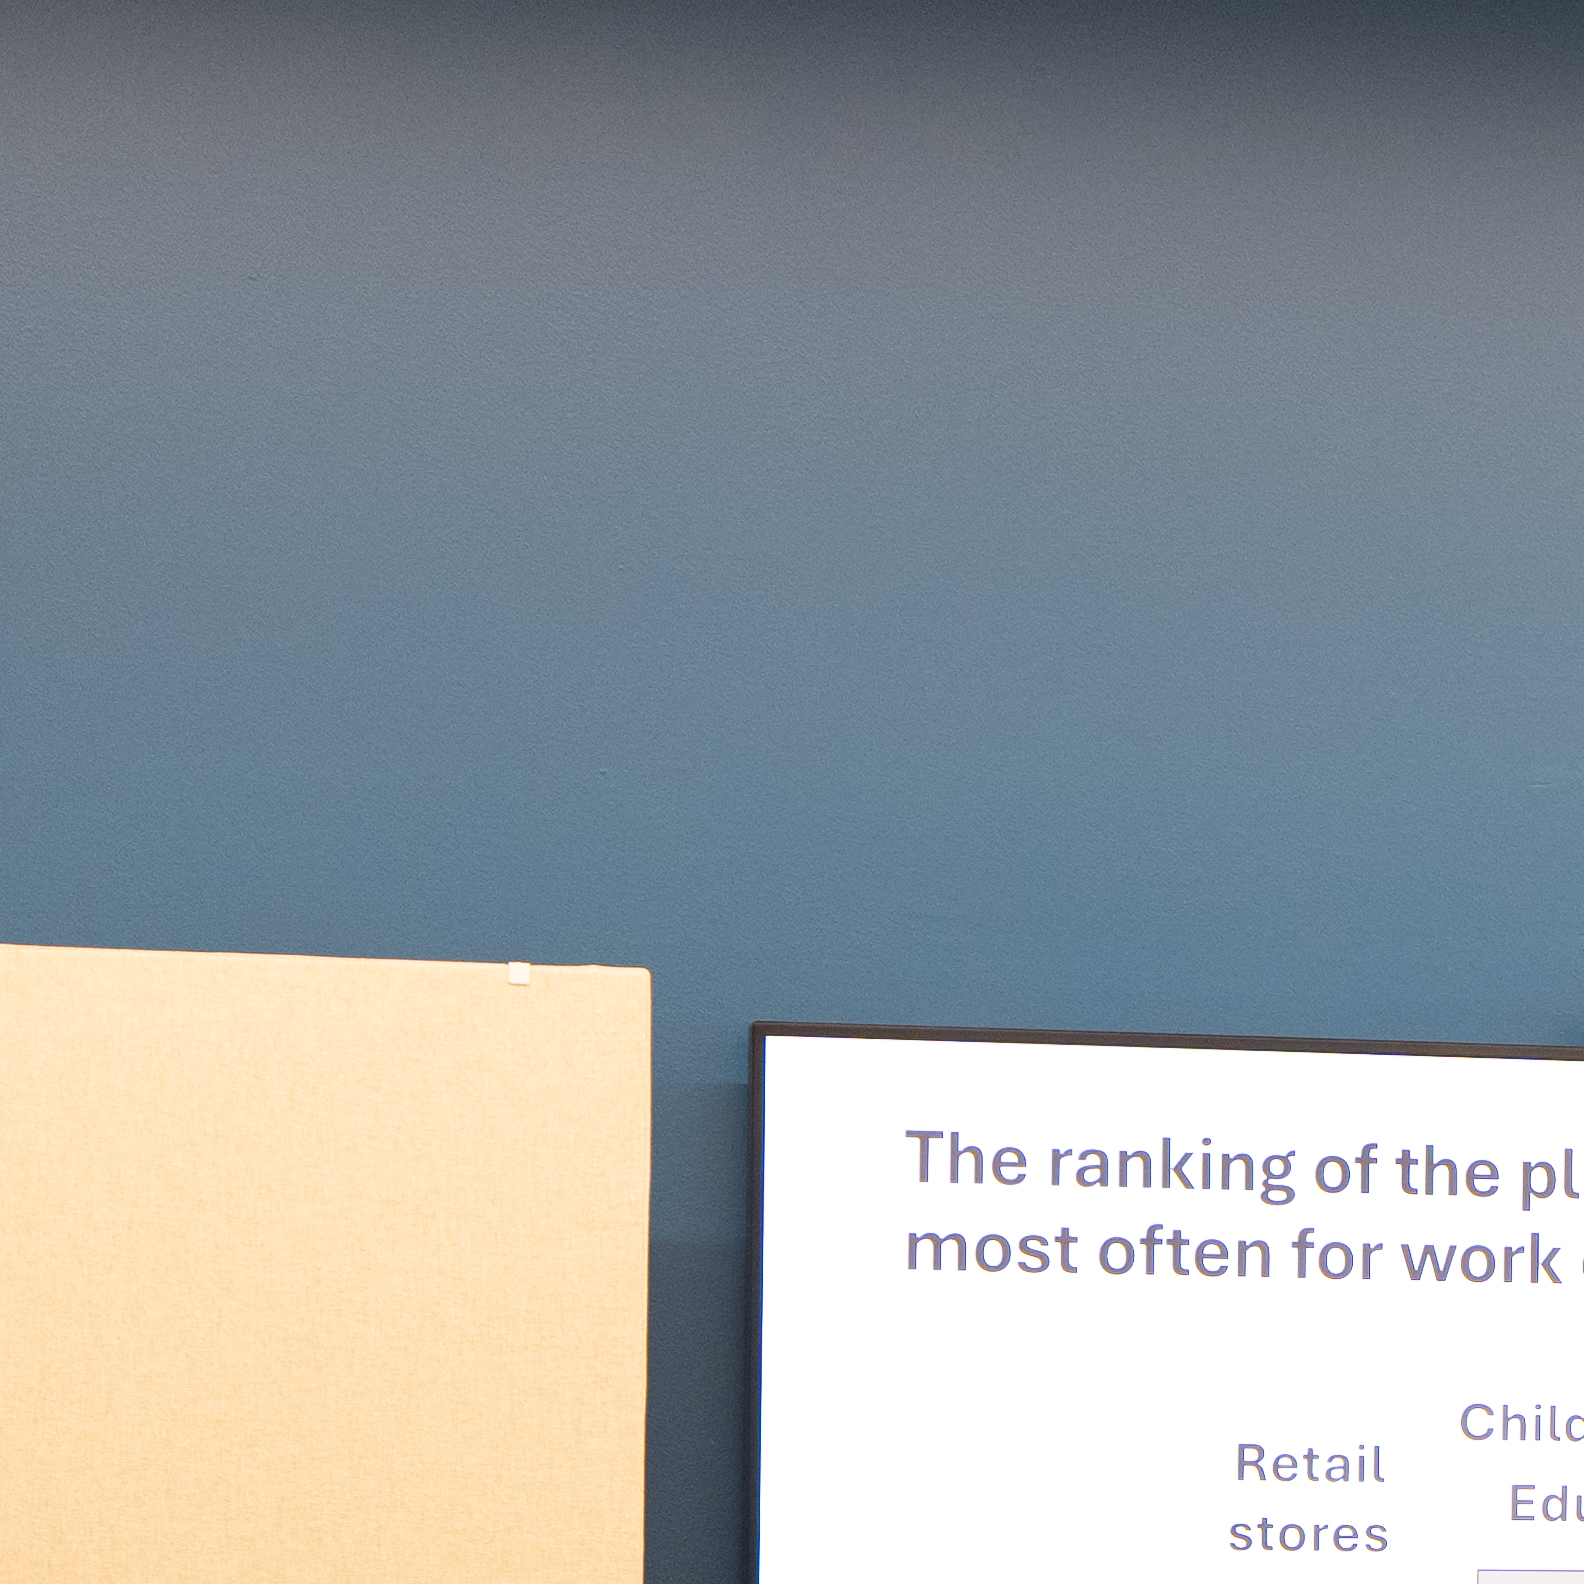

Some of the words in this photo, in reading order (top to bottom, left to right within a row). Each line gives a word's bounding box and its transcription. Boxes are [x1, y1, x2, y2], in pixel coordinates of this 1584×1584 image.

[905, 1130, 1026, 1185] The
[1051, 1137, 1295, 1206] ranking
[1315, 1143, 1378, 1193] of
[1395, 1145, 1499, 1197] the
[908, 1227, 1078, 1273] most
[1099, 1224, 1270, 1277] often
[1291, 1227, 1383, 1279] for
[1401, 1233, 1562, 1284] work
[1238, 1444, 1384, 1482] Retail
[1230, 1517, 1387, 1552] stores
